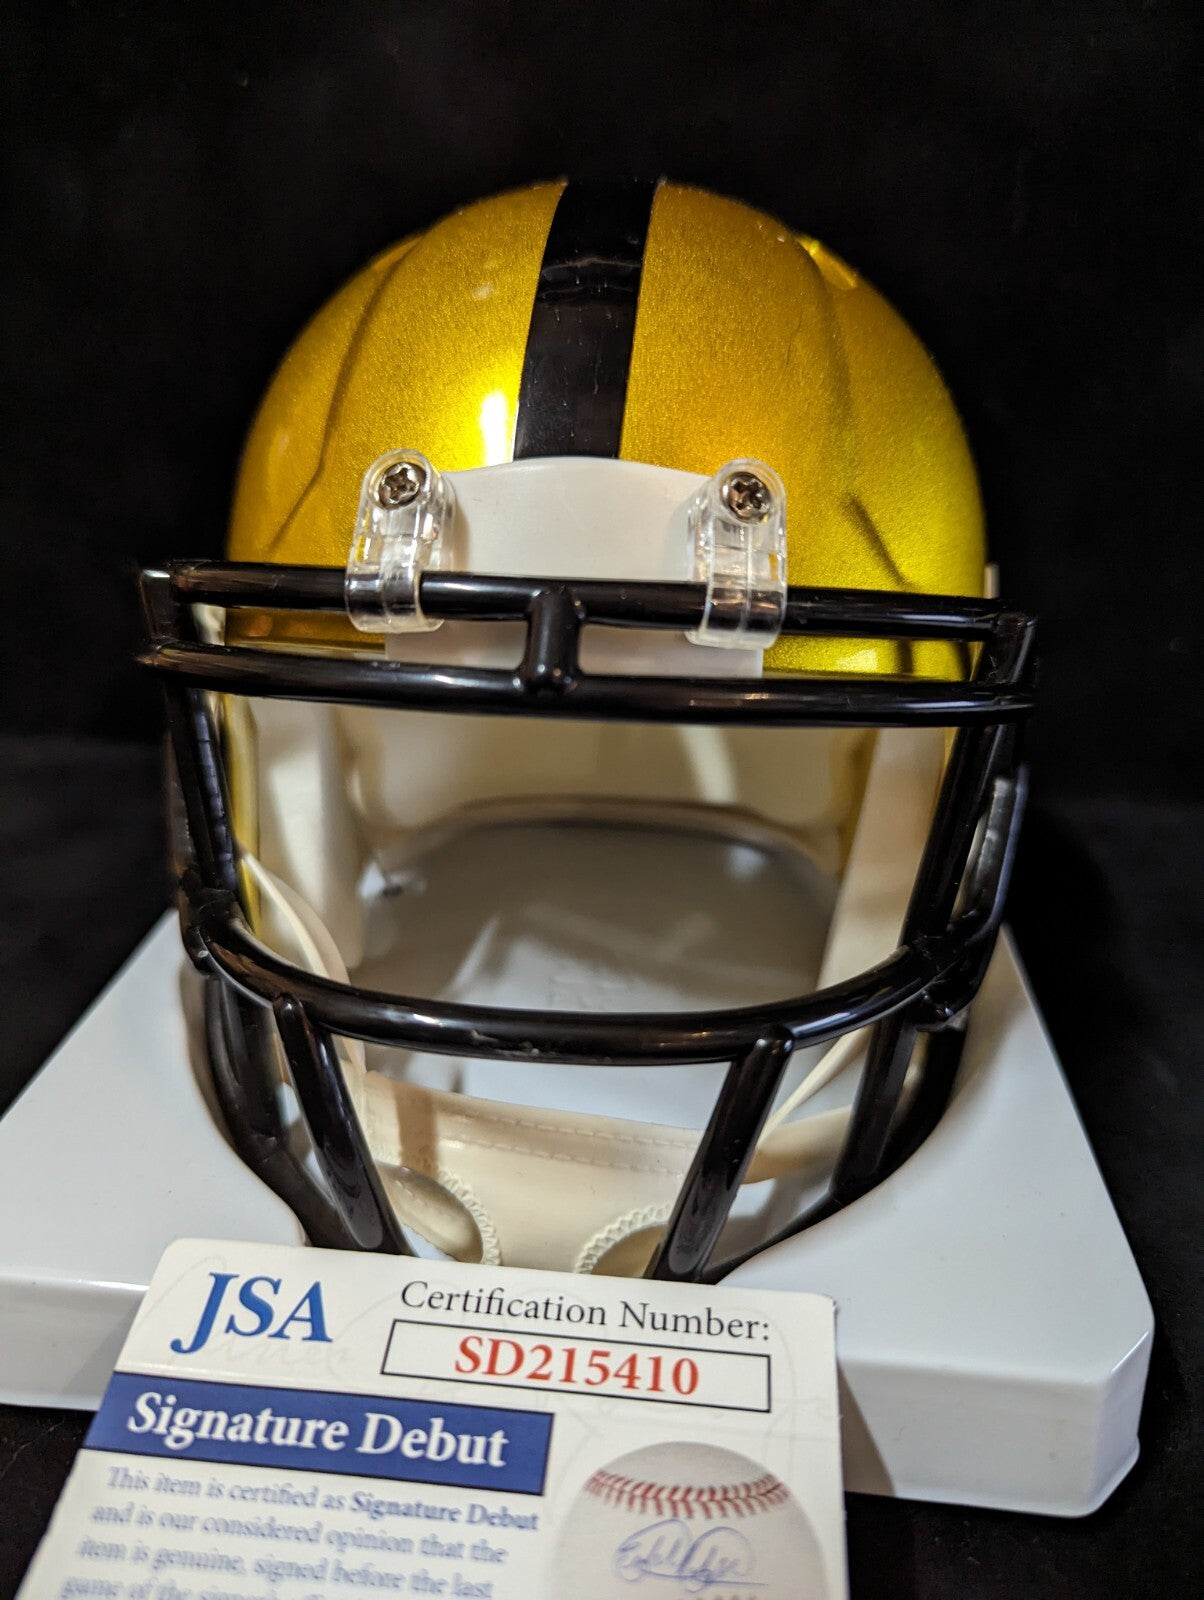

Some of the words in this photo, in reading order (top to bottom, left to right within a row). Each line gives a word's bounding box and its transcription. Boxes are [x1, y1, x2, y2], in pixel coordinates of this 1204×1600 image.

[170, 1271, 333, 1355] JSA
[401, 1279, 606, 1326] Certification
[619, 1300, 770, 1341] Number:
[454, 1335, 699, 1396] SD215410
[127, 1391, 349, 1451] Signature
[357, 1411, 509, 1467] Debut
[106, 1466, 149, 1490] This
[153, 1472, 201, 1496] item
[206, 1478, 225, 1498] is
[229, 1483, 319, 1508] certified
[321, 1493, 345, 1509] as
[351, 1490, 461, 1523] Signature
[466, 1502, 540, 1530] Debut
[92, 1501, 135, 1523] and
[137, 1506, 155, 1526] is
[158, 1511, 199, 1531] our
[202, 1515, 323, 1544] considered
[325, 1527, 414, 1553] opinion
[419, 1533, 466, 1559] that
[470, 1538, 507, 1563] the
[77, 1535, 127, 1559] item
[131, 1541, 149, 1562] is
[254, 1554, 329, 1583] signed
[330, 1559, 405, 1590] before
[410, 1568, 449, 1594] the
[451, 1572, 495, 1600] last
